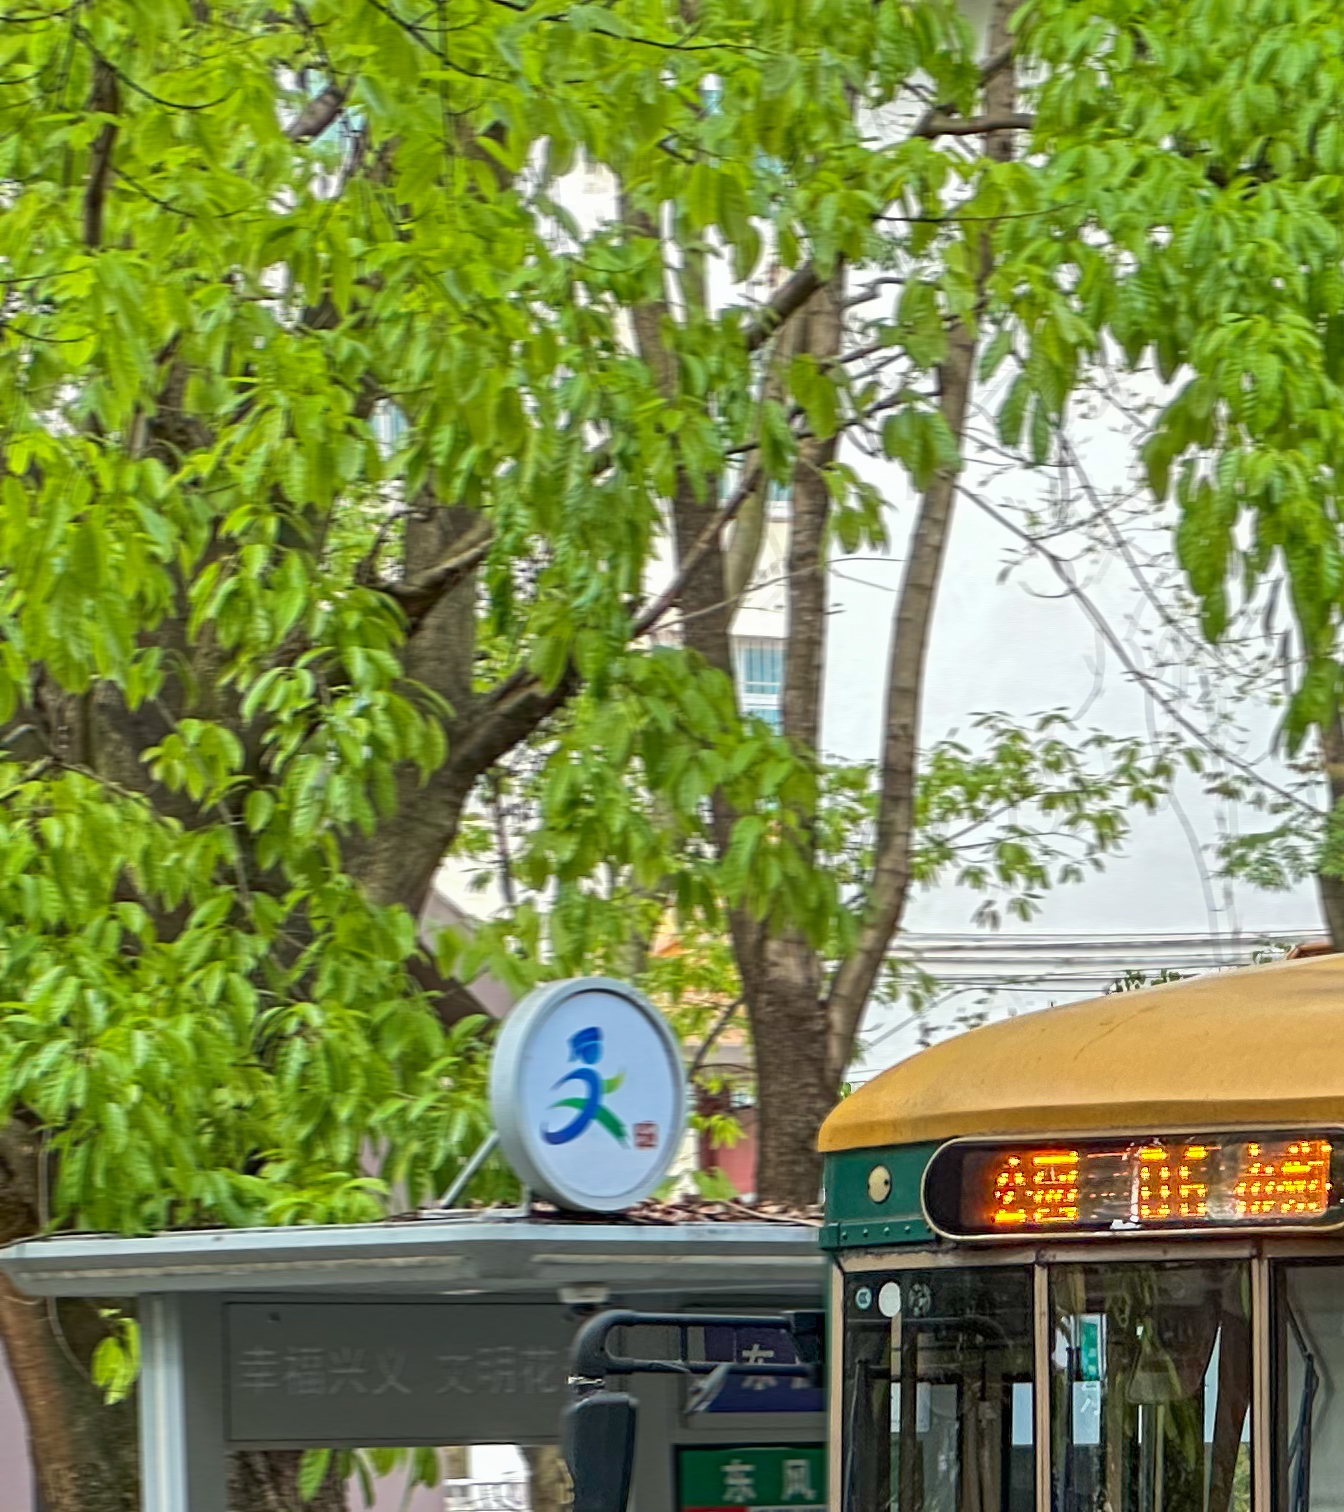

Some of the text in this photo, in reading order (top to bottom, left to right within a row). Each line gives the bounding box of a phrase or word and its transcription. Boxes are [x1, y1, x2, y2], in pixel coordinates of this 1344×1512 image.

[238, 1347, 568, 1395] 幸福兴义 文明花
